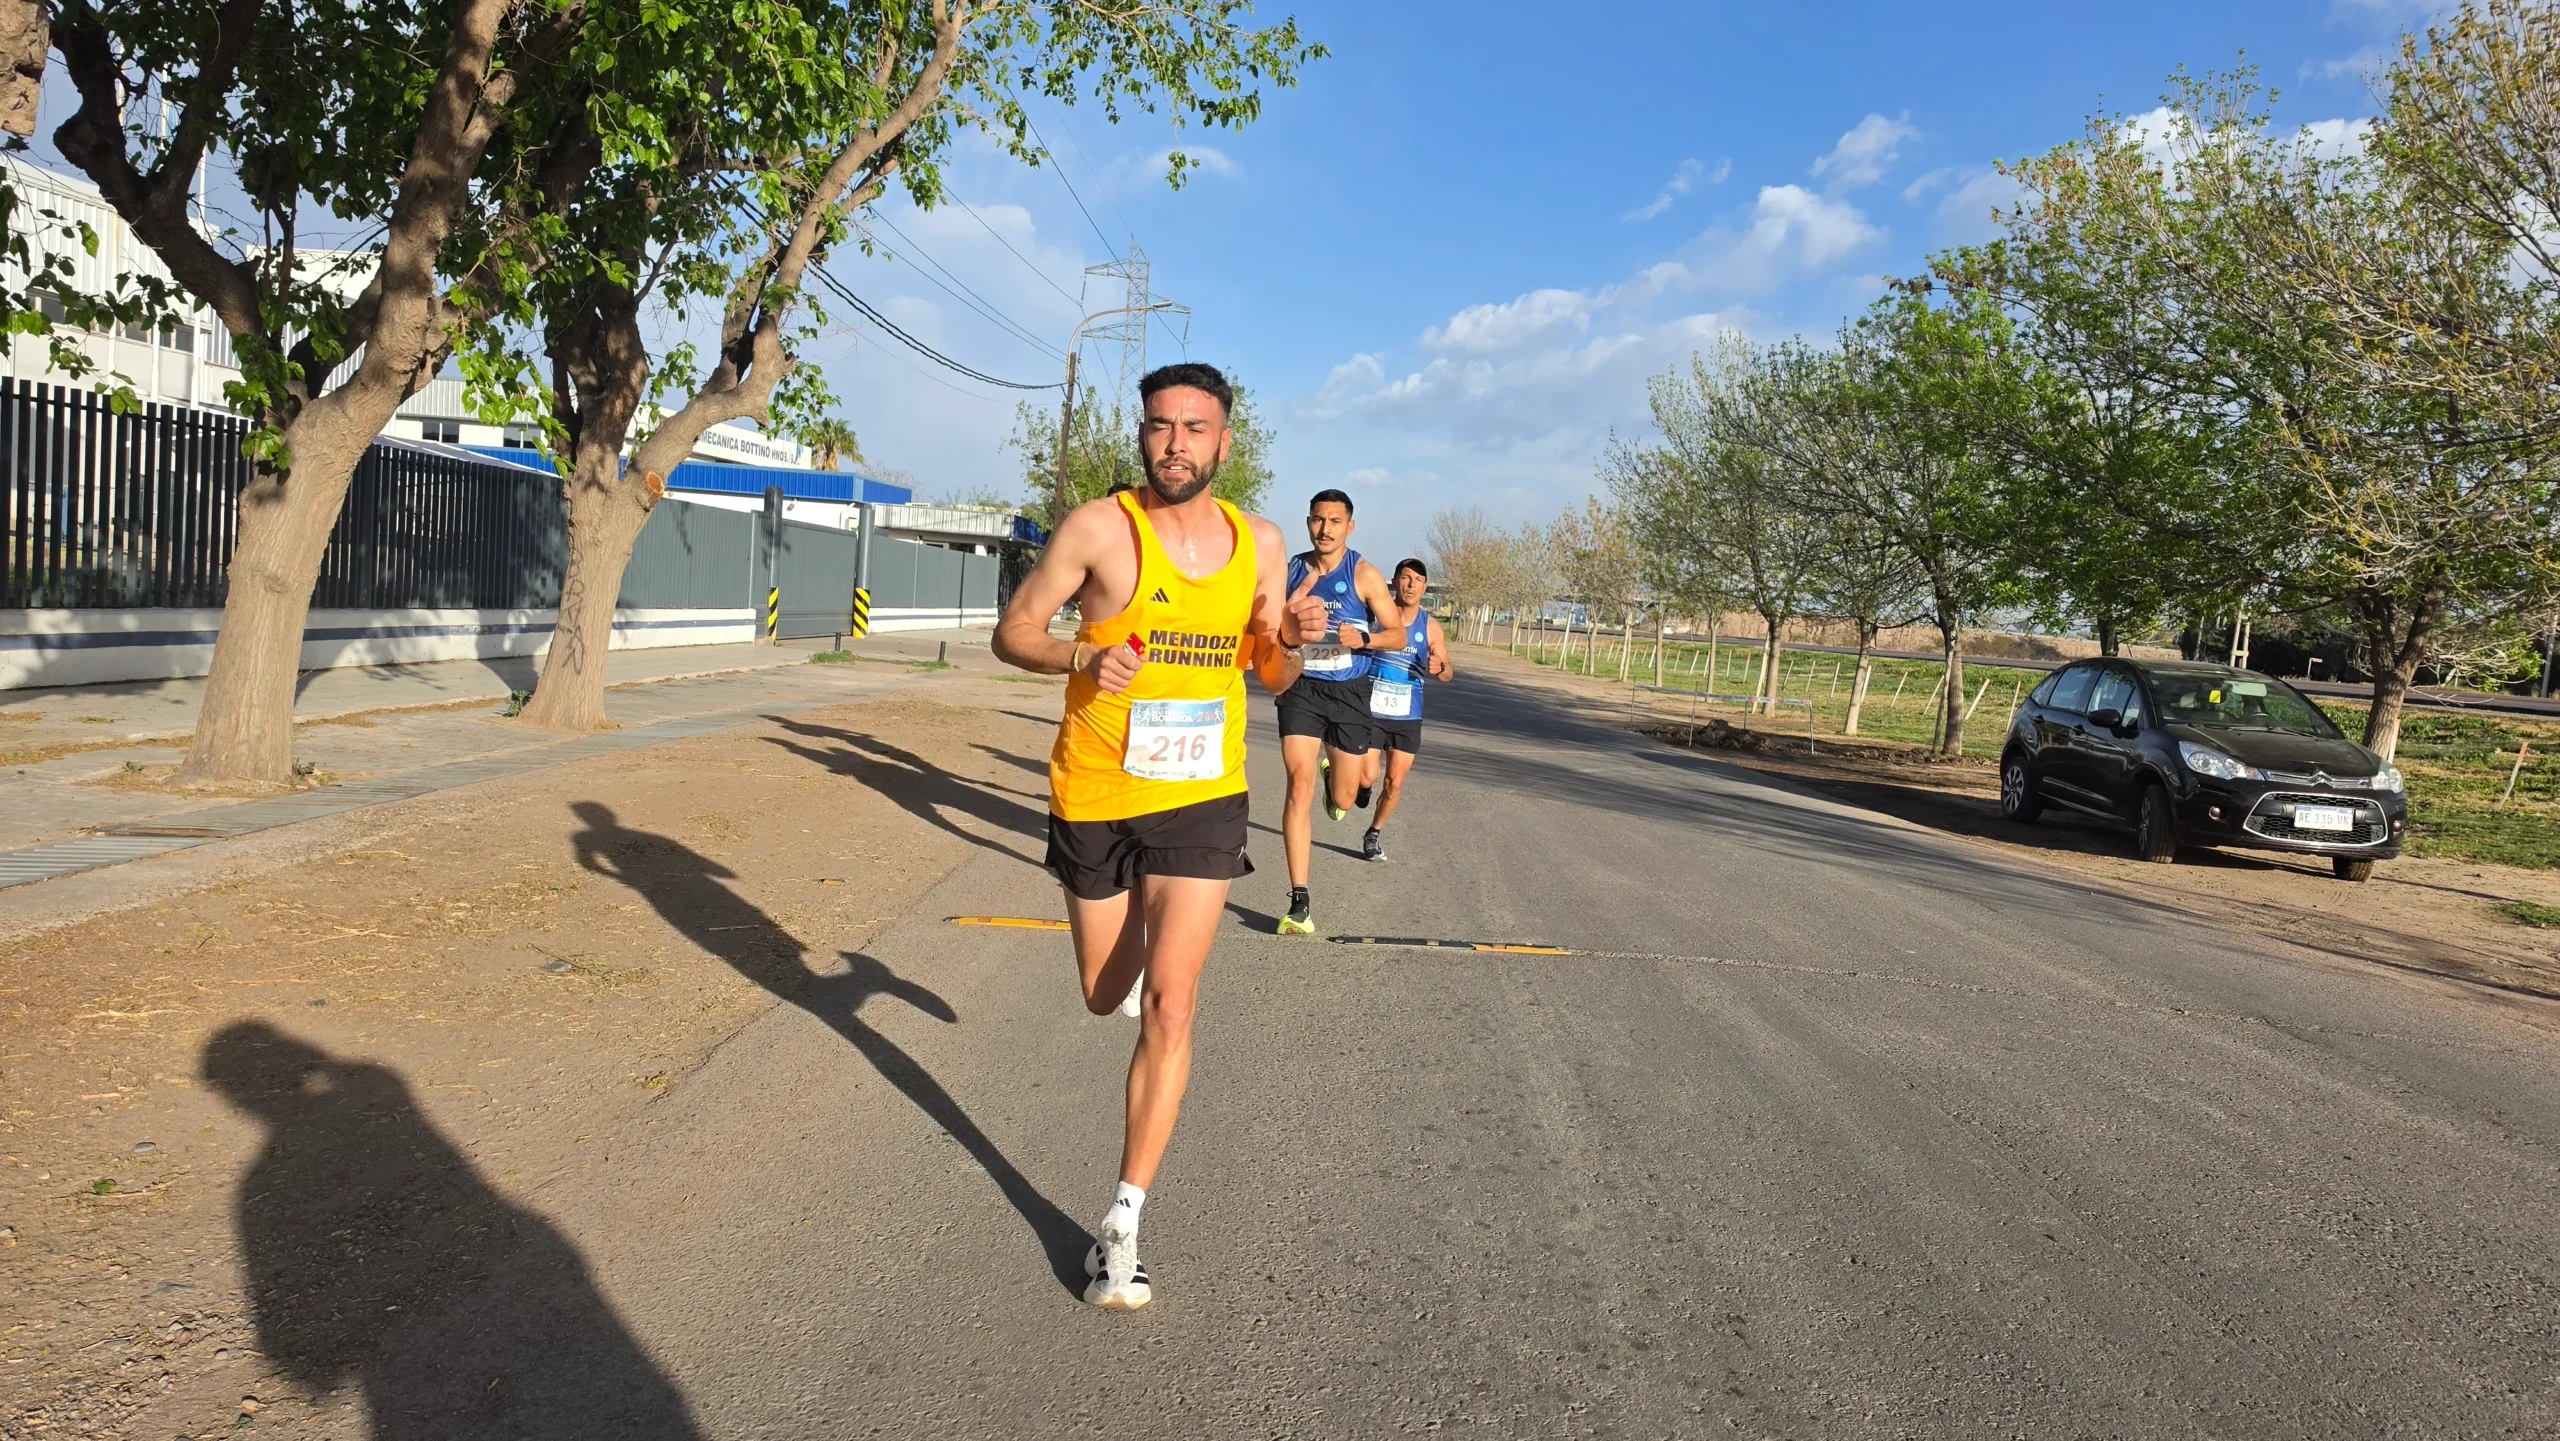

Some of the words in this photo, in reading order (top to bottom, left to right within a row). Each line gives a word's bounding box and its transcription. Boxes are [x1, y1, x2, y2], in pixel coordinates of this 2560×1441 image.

[740, 439, 771, 458] BOTTINO
[1148, 629, 1238, 650] MENDOZA
[1148, 647, 1233, 668] RUNNING
[1311, 647, 1341, 661] 229
[1383, 696, 1398, 708] 13
[1148, 733, 1207, 762] 216
